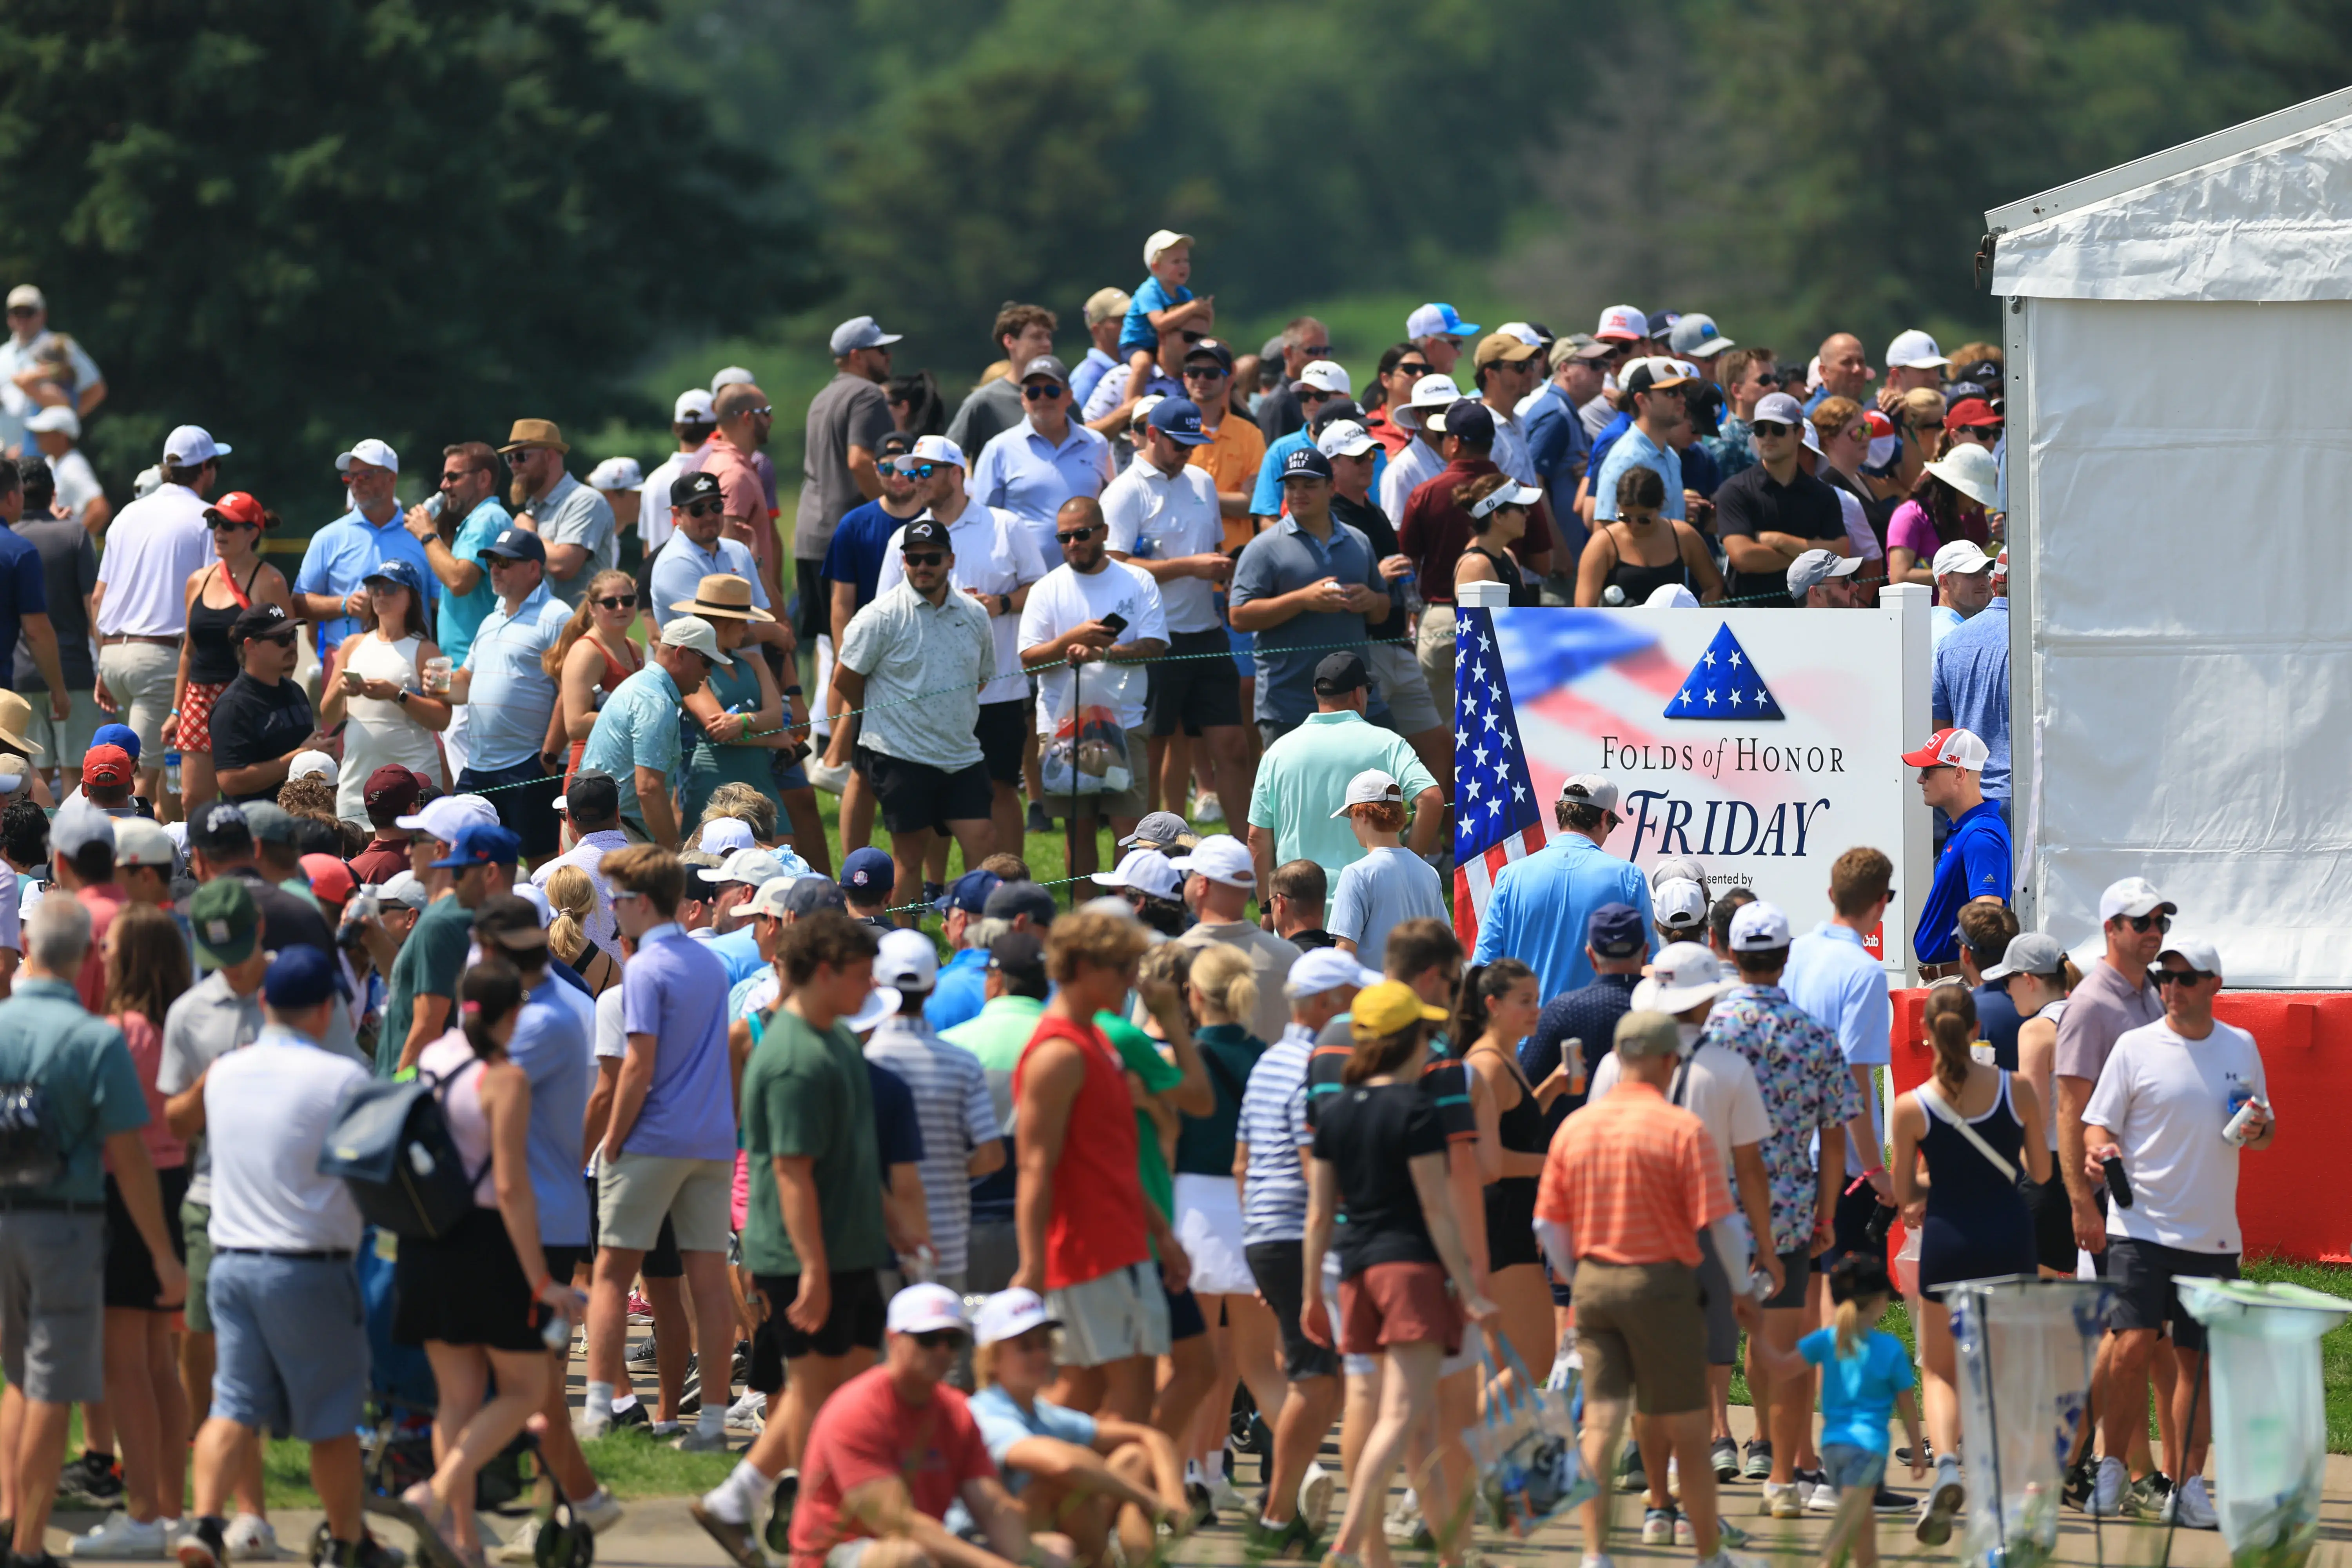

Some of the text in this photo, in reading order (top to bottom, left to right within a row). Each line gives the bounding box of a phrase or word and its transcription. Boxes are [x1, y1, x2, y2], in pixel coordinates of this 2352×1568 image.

[1601, 736, 1845, 779] FOLDS of HONOR
[1946, 754, 1961, 764] 3M
[1626, 789, 1830, 863] FRIDAY
[1706, 873, 1753, 887] sented by
[1862, 934, 1879, 947] Cub
